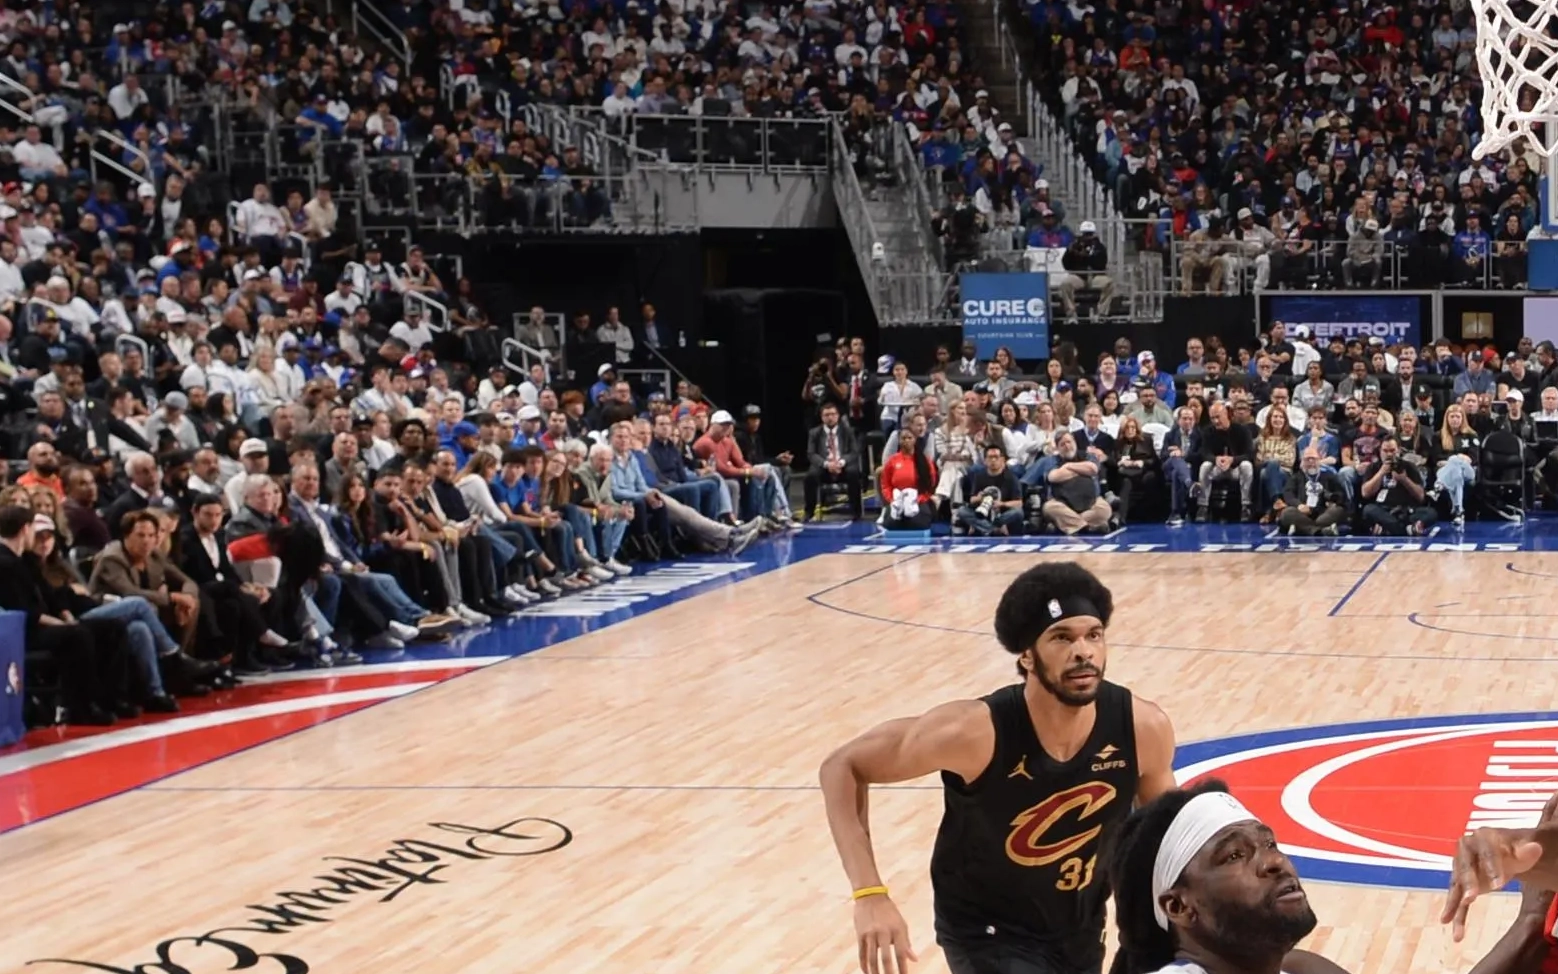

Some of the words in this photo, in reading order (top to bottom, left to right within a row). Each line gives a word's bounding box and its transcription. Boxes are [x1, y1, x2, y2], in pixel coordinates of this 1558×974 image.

[962, 299, 1026, 317] CURE
[964, 317, 989, 326] AUTO
[991, 316, 1046, 325] INSURANCE
[839, 544, 1168, 553] DETROIT
[1199, 543, 1521, 552] PISTONS
[1091, 759, 1127, 772] CLIFFS
